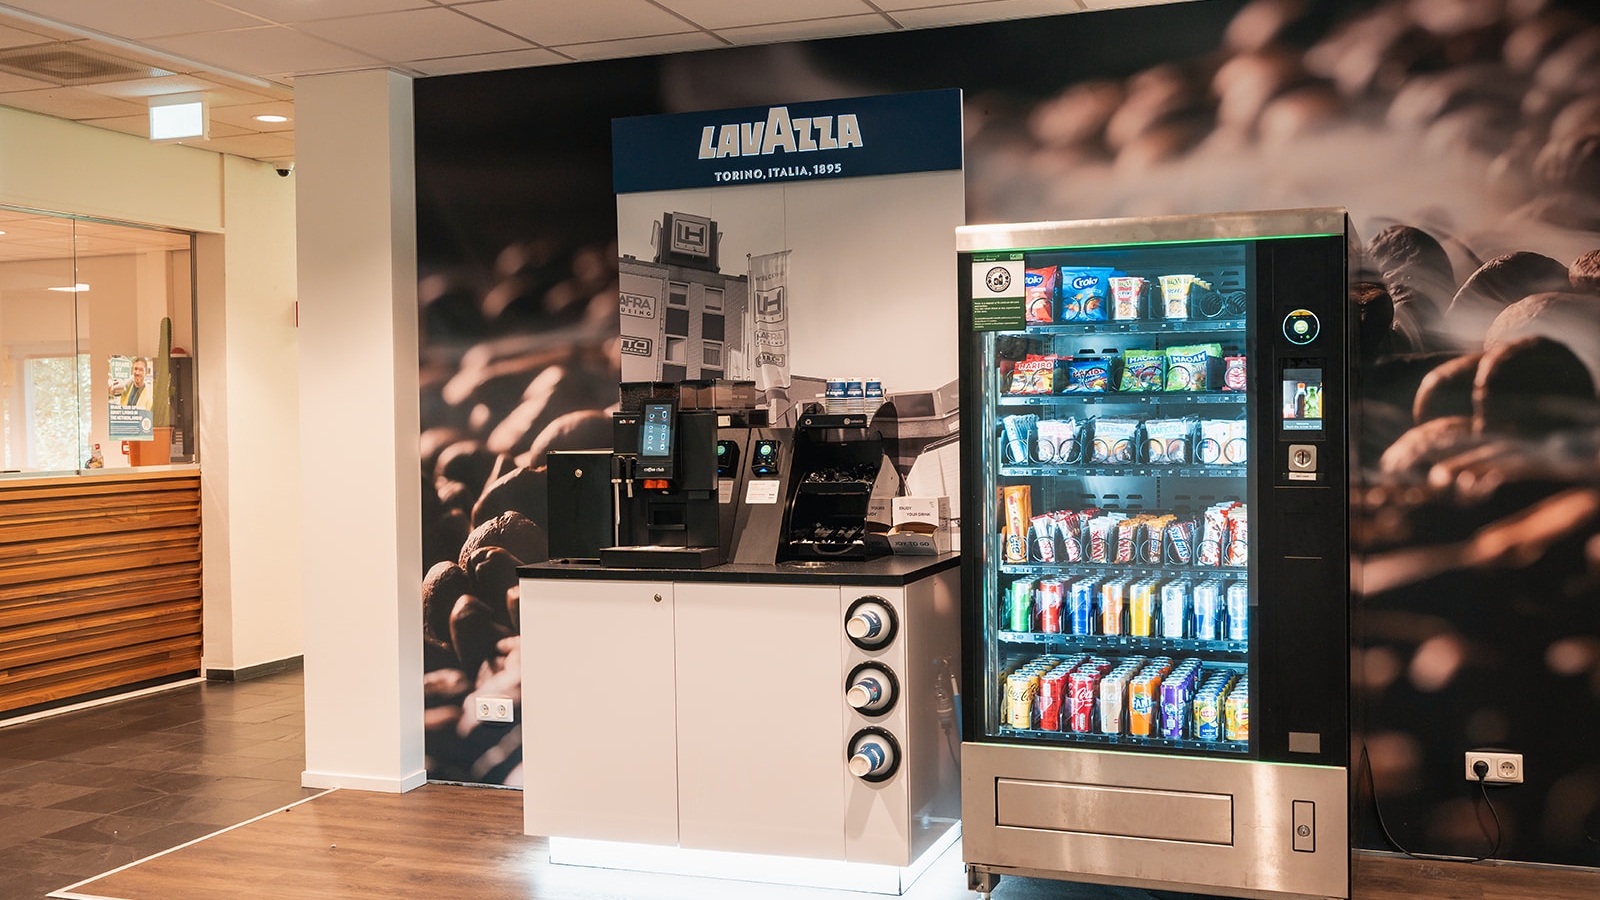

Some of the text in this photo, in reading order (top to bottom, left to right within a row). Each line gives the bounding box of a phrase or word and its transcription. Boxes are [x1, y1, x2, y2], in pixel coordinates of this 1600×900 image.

[698, 106, 863, 160] LAVAZZA
[714, 163, 842, 182] TORINO, ITALIA, 1895
[1018, 360, 1054, 371] HARIBO
[1171, 353, 1207, 364] MAOAM
